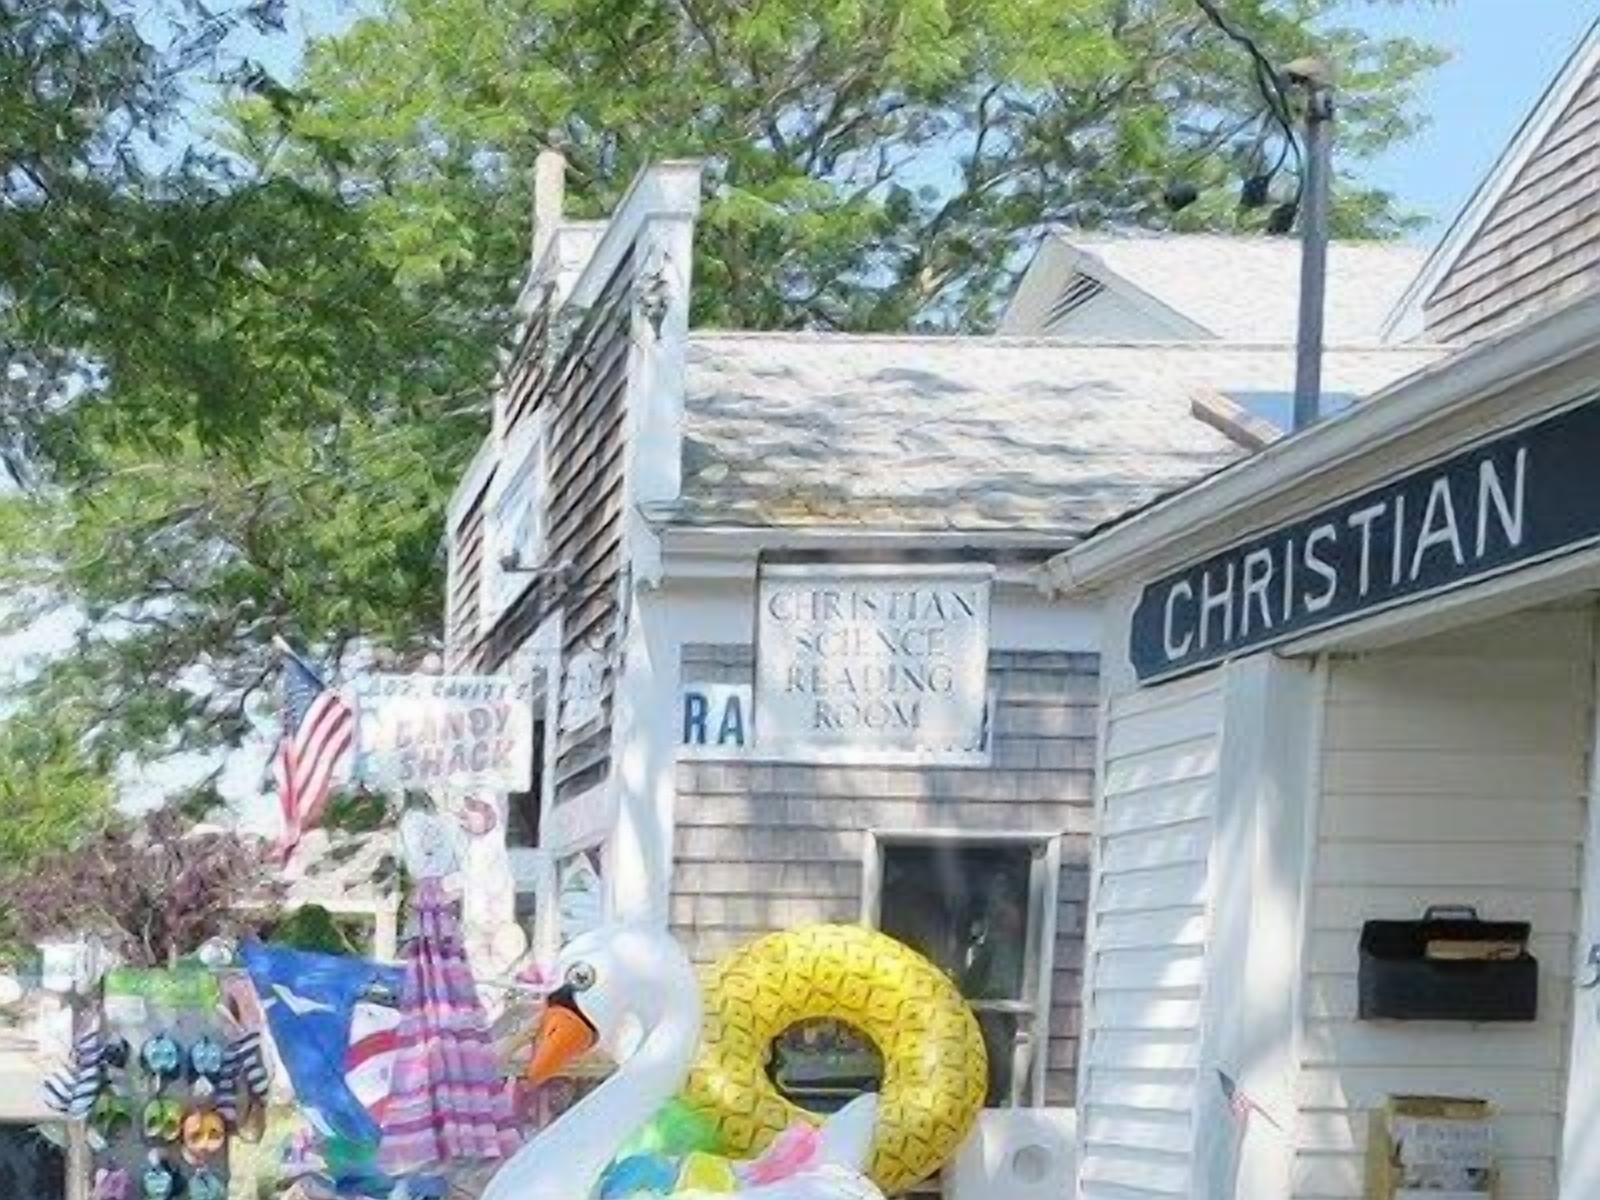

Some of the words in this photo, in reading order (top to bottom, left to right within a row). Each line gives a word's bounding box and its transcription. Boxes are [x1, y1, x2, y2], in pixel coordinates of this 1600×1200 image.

[1162, 447, 1527, 661] CHRISTIAN
[768, 590, 977, 621] CHRISTIAN
[795, 627, 947, 657] SCIENCE
[786, 663, 953, 694] READING
[813, 699, 921, 729] ROOM
